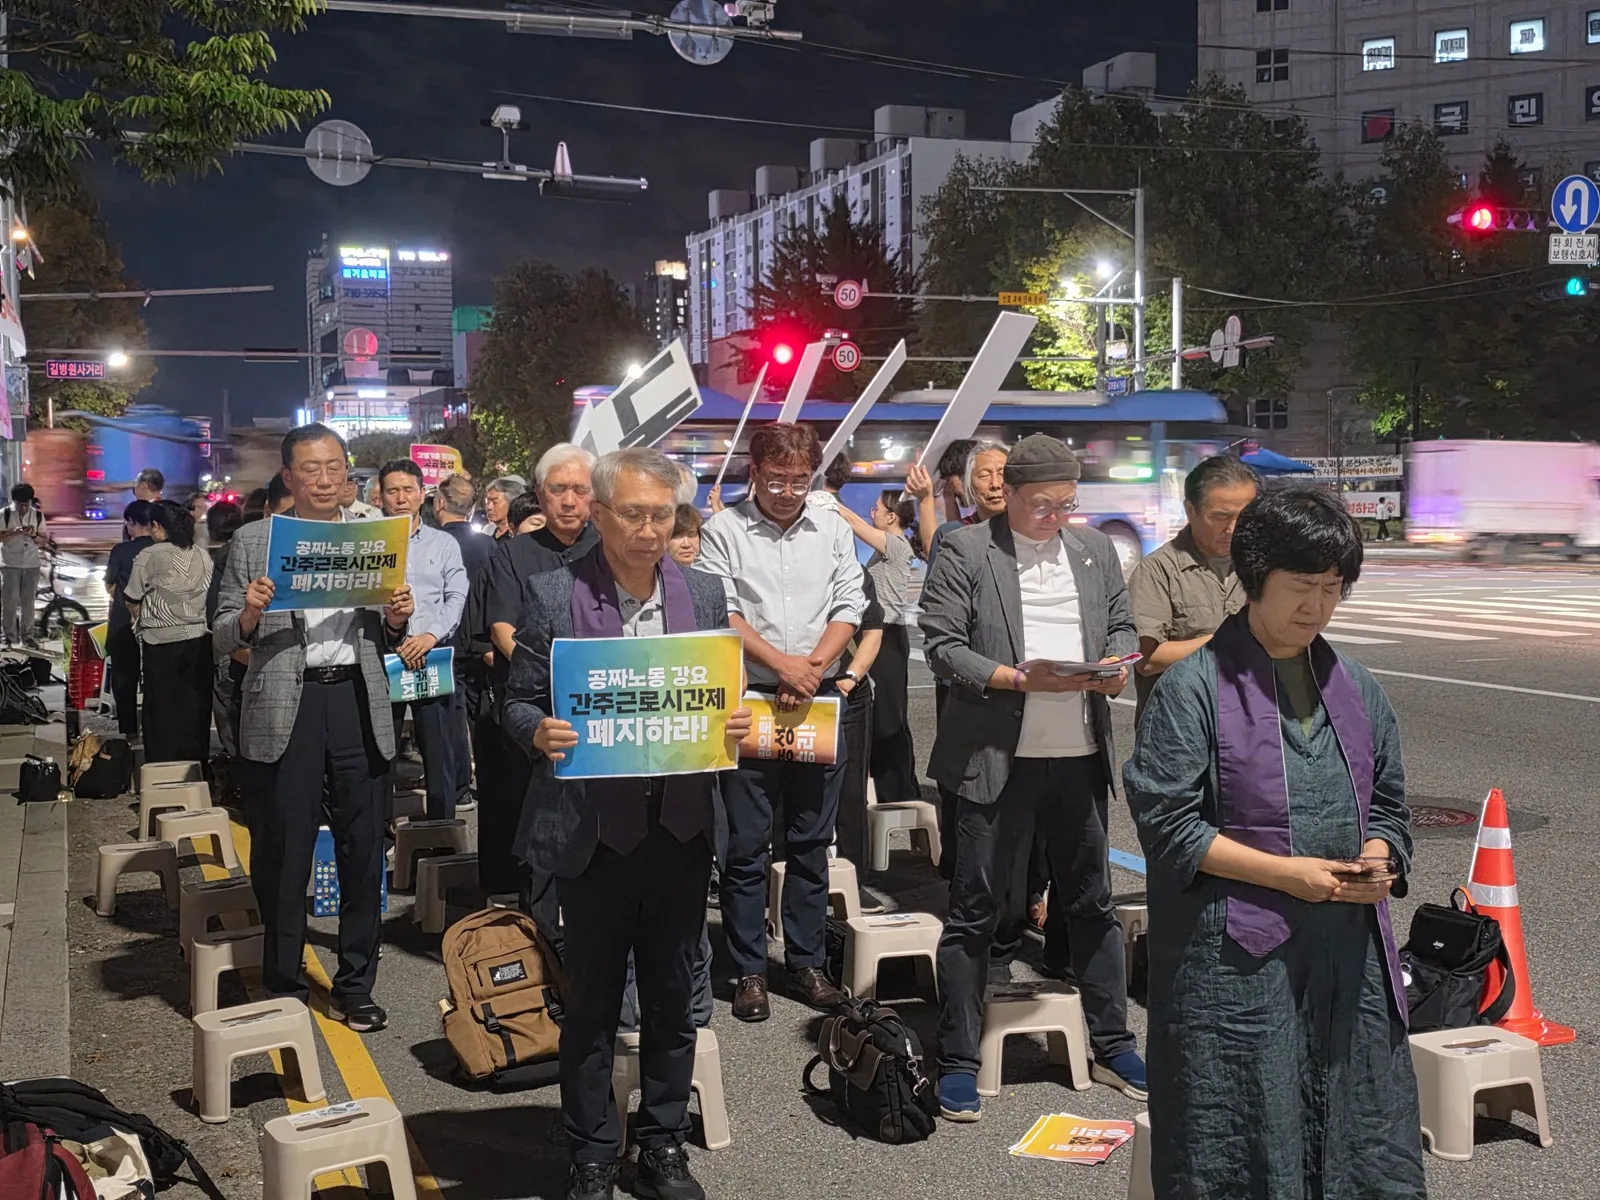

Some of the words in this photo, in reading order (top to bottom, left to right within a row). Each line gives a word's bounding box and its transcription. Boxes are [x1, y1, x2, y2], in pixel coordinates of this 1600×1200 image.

[1514, 97, 1537, 123] 민
[1552, 250, 1595, 260] 보행신호시
[840, 288, 856, 301] 50
[838, 350, 854, 363] 50
[49, 363, 104, 377] 길병원사거리
[296, 541, 356, 556] 공짜노동
[359, 540, 386, 555] 강요
[280, 553, 397, 572] 간주근로시간제
[290, 572, 382, 592] 폐지하라!
[587, 667, 665, 690] 공짜노동
[670, 665, 708, 687] 강요
[568, 687, 726, 716] 간주근로시간제
[586, 715, 708, 747] 폐지하라!
